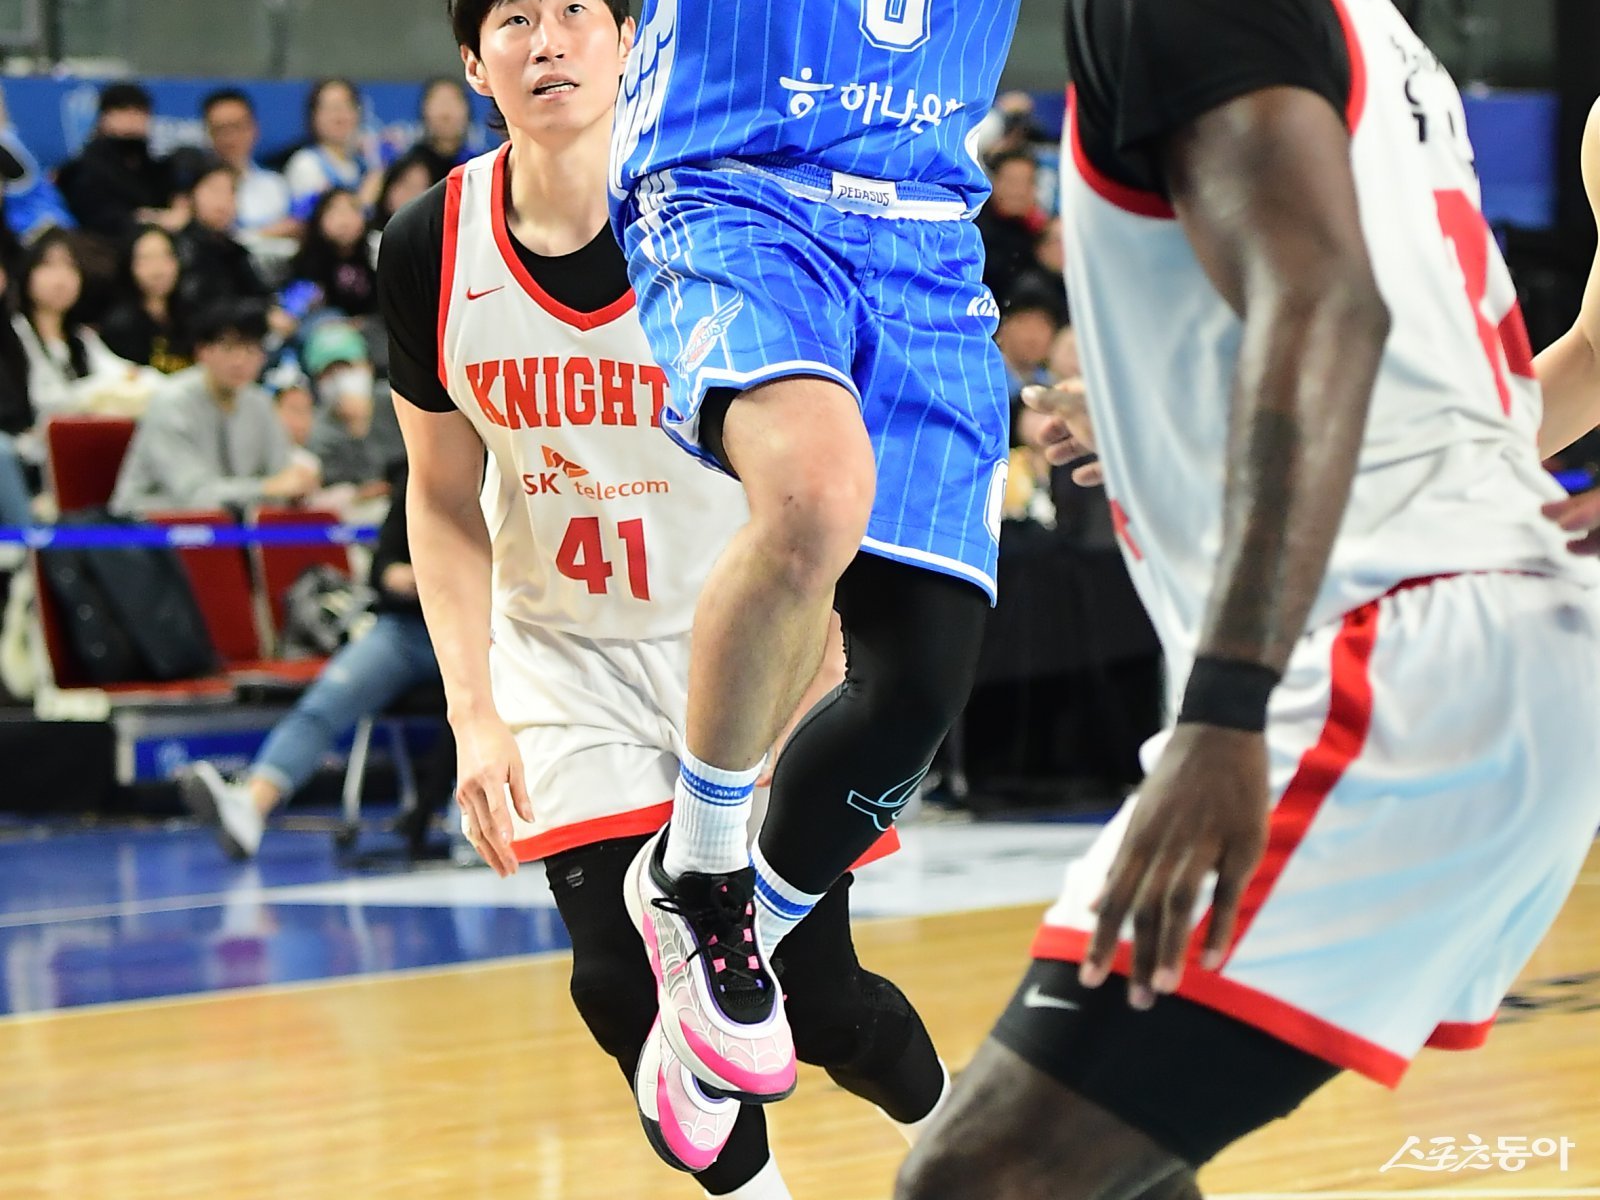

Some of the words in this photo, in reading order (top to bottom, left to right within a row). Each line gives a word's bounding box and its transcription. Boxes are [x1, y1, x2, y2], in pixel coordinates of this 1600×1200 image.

[838, 184, 890, 207] PEGASUS
[523, 473, 562, 495] SK
[573, 479, 669, 501] telecom
[555, 516, 651, 601] 41
